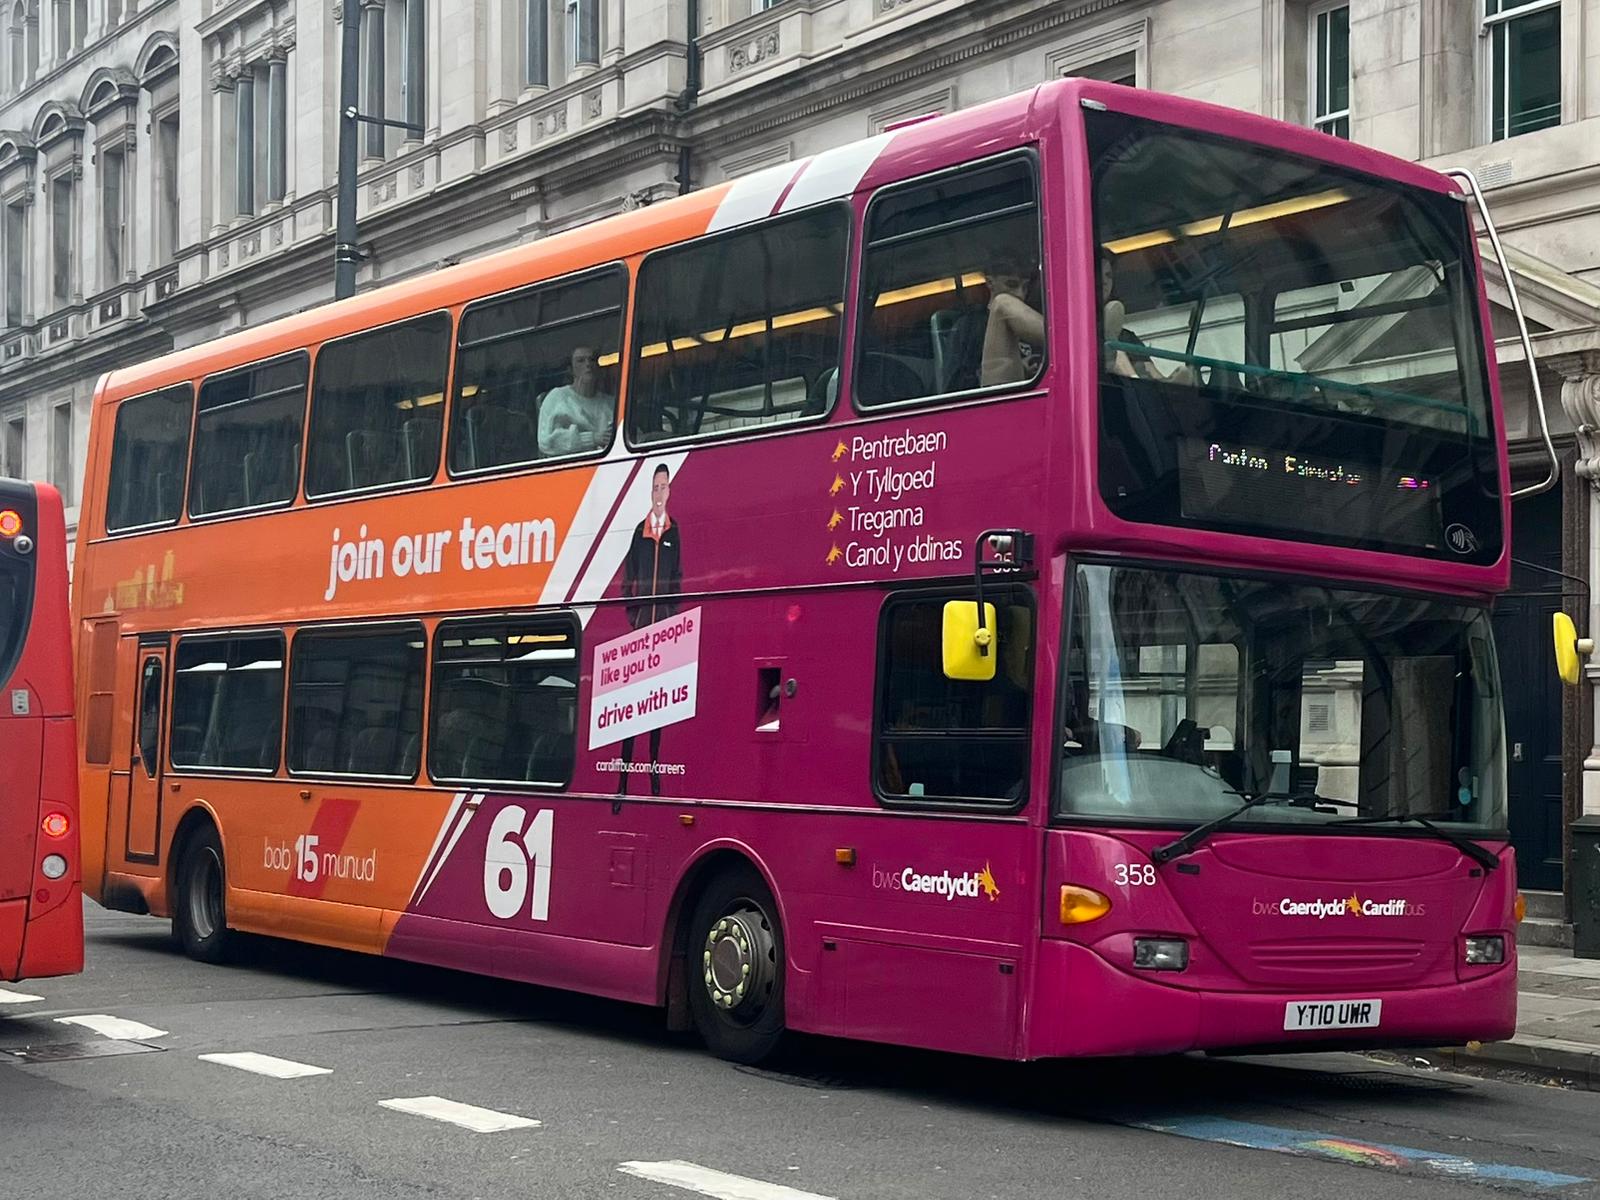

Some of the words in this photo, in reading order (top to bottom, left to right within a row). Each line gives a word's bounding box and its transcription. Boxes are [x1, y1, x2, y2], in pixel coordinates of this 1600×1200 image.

[851, 429, 947, 462] Pentrebaen
[850, 470, 863, 497] Y
[866, 461, 936, 502] Tyllgoed
[848, 506, 924, 537] Treganna
[324, 523, 384, 601] join
[391, 531, 452, 577] our
[459, 516, 556, 570] team
[845, 538, 891, 568] Canol
[893, 545, 904, 573] y
[907, 535, 963, 563] ddinas
[993, 552, 1021, 574] 35
[601, 647, 618, 664] we
[620, 632, 650, 657] want
[652, 616, 694, 651] people
[600, 668, 620, 687] like
[623, 660, 645, 684] you
[647, 652, 661, 669] to
[597, 703, 634, 729] drive
[637, 687, 668, 716] with
[671, 684, 689, 705] us
[595, 757, 686, 775] cardiffbus.com/careers
[263, 836, 291, 871] bob
[295, 834, 320, 882] 15
[322, 848, 377, 882] munud
[484, 804, 554, 921] 61
[1114, 863, 1156, 886] 358
[1297, 1004, 1333, 1026] YT10
[1339, 1003, 1371, 1024] UWR
